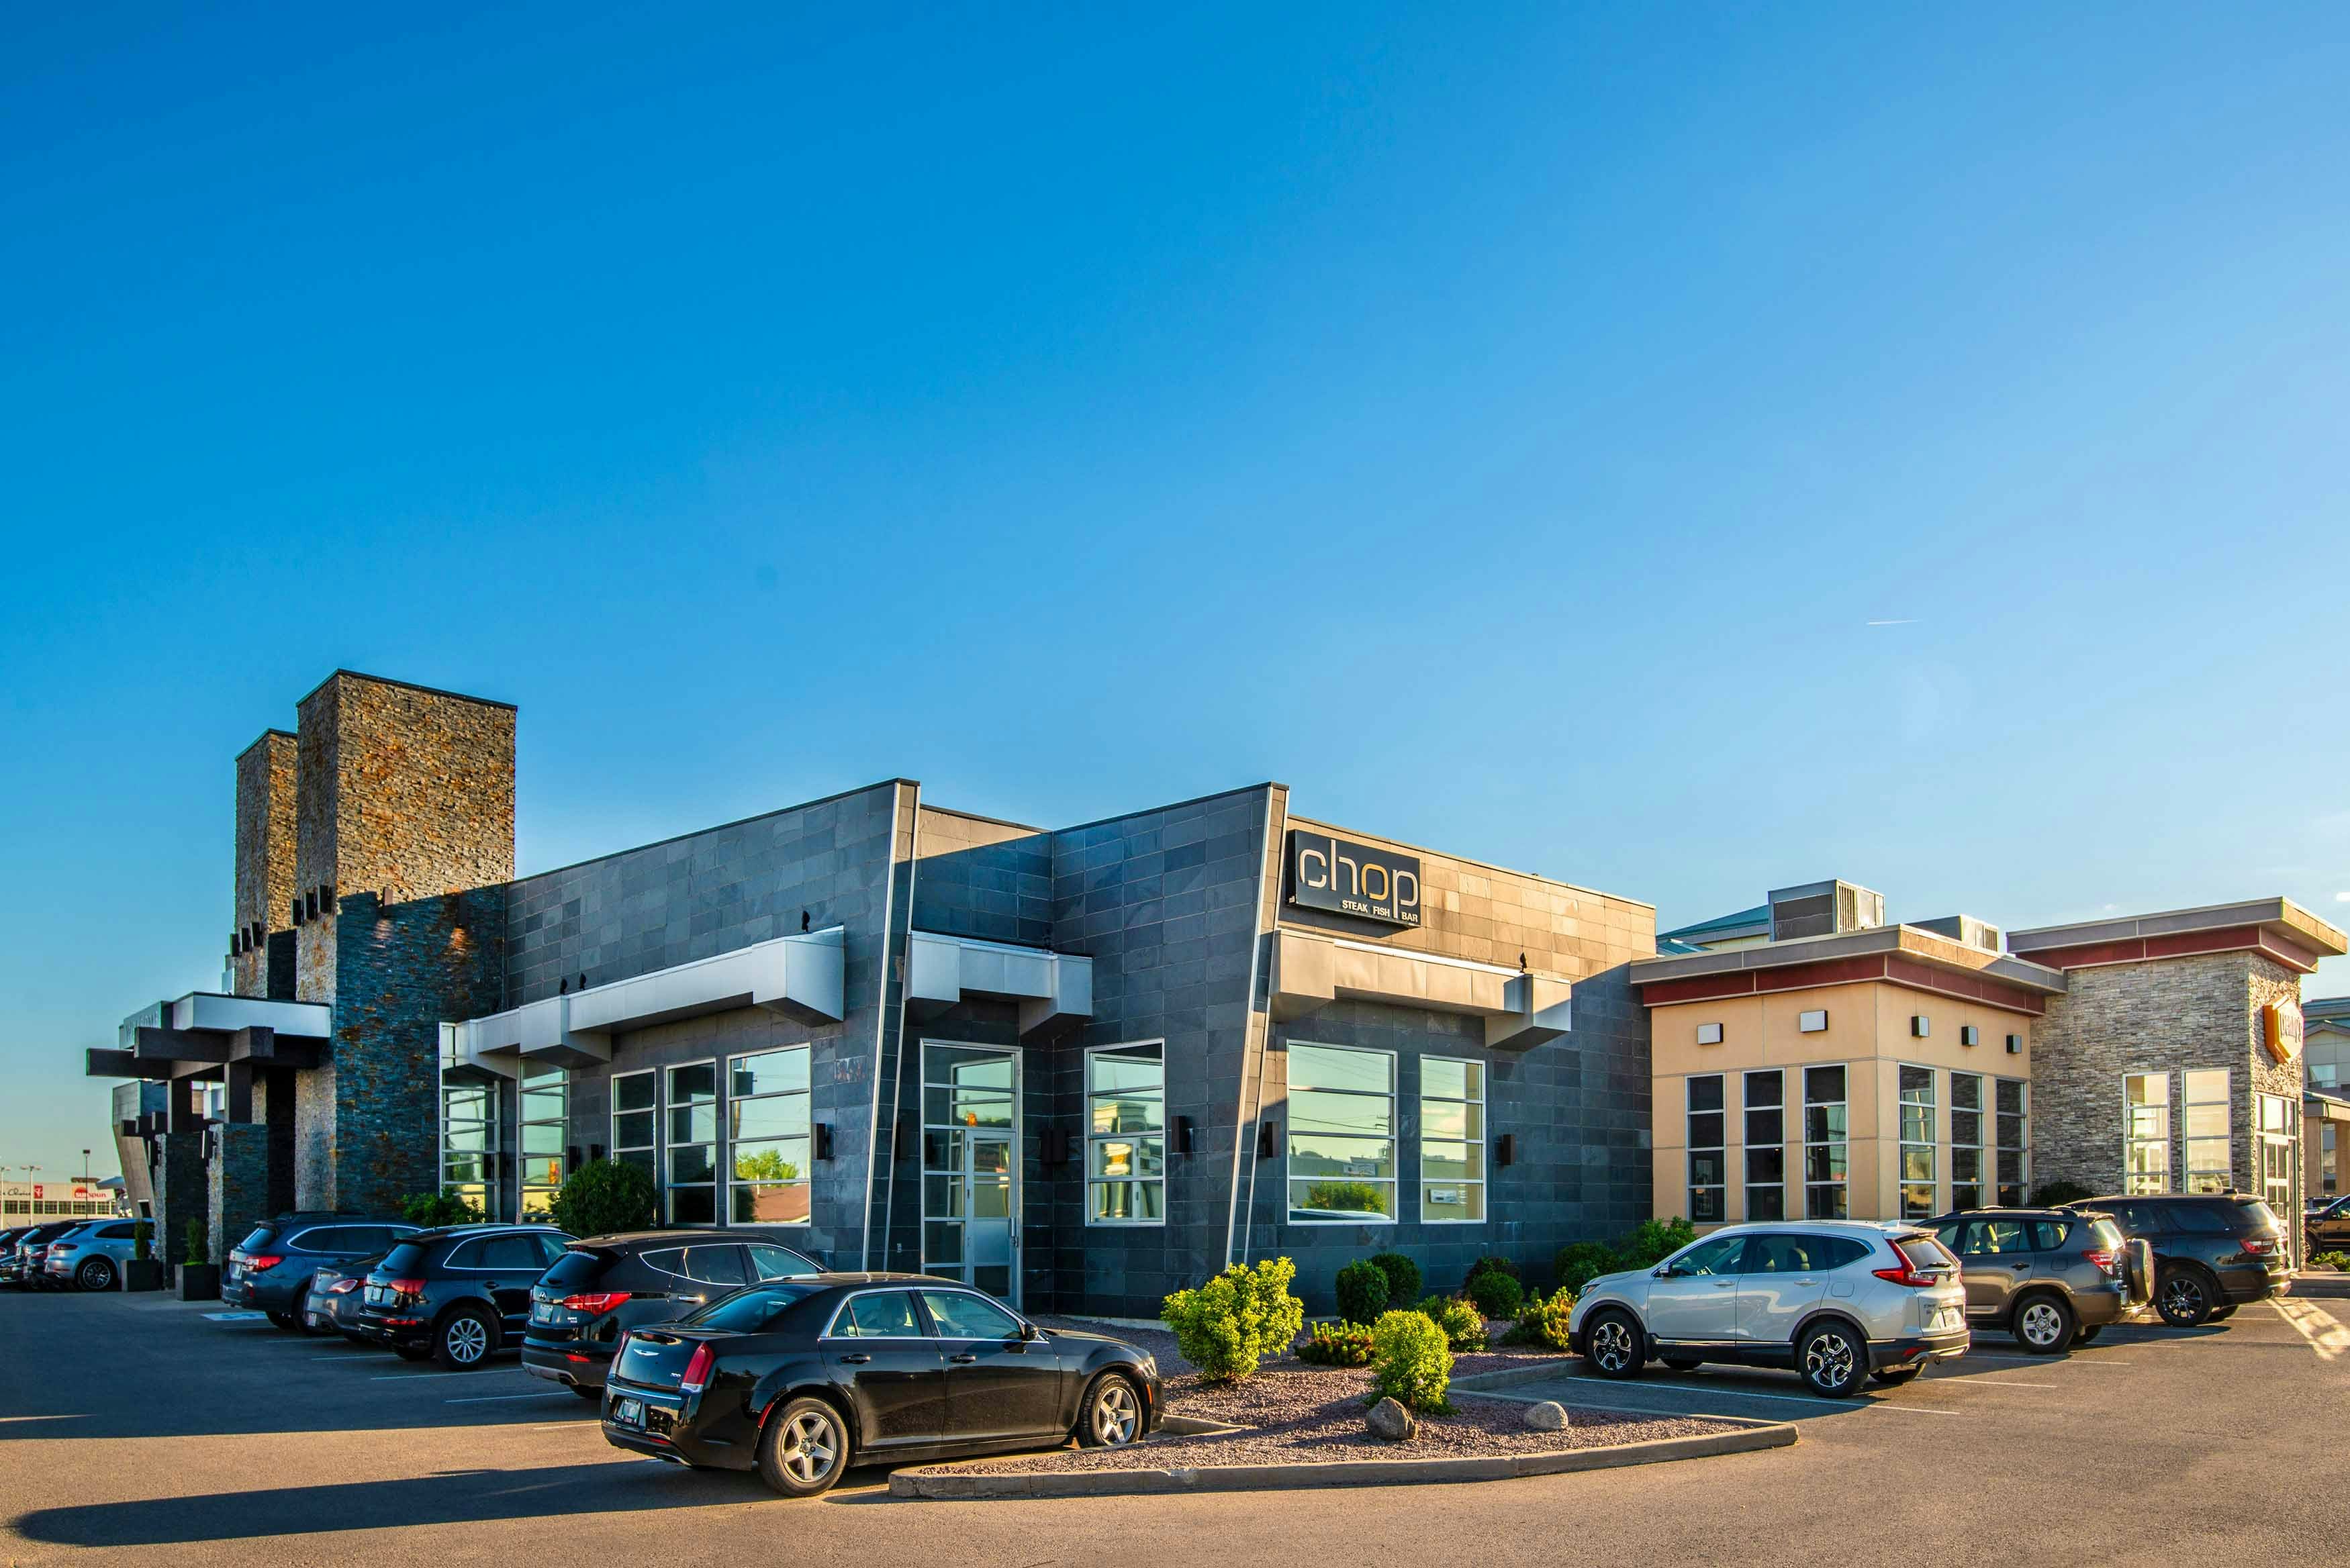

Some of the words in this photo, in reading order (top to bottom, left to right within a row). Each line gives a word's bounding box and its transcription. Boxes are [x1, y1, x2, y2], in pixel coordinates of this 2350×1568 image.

[1299, 838, 1419, 919] chop
[1342, 899, 1368, 913] STEAK
[1372, 906, 1391, 918] FISH
[1401, 912, 1419, 922] BAR
